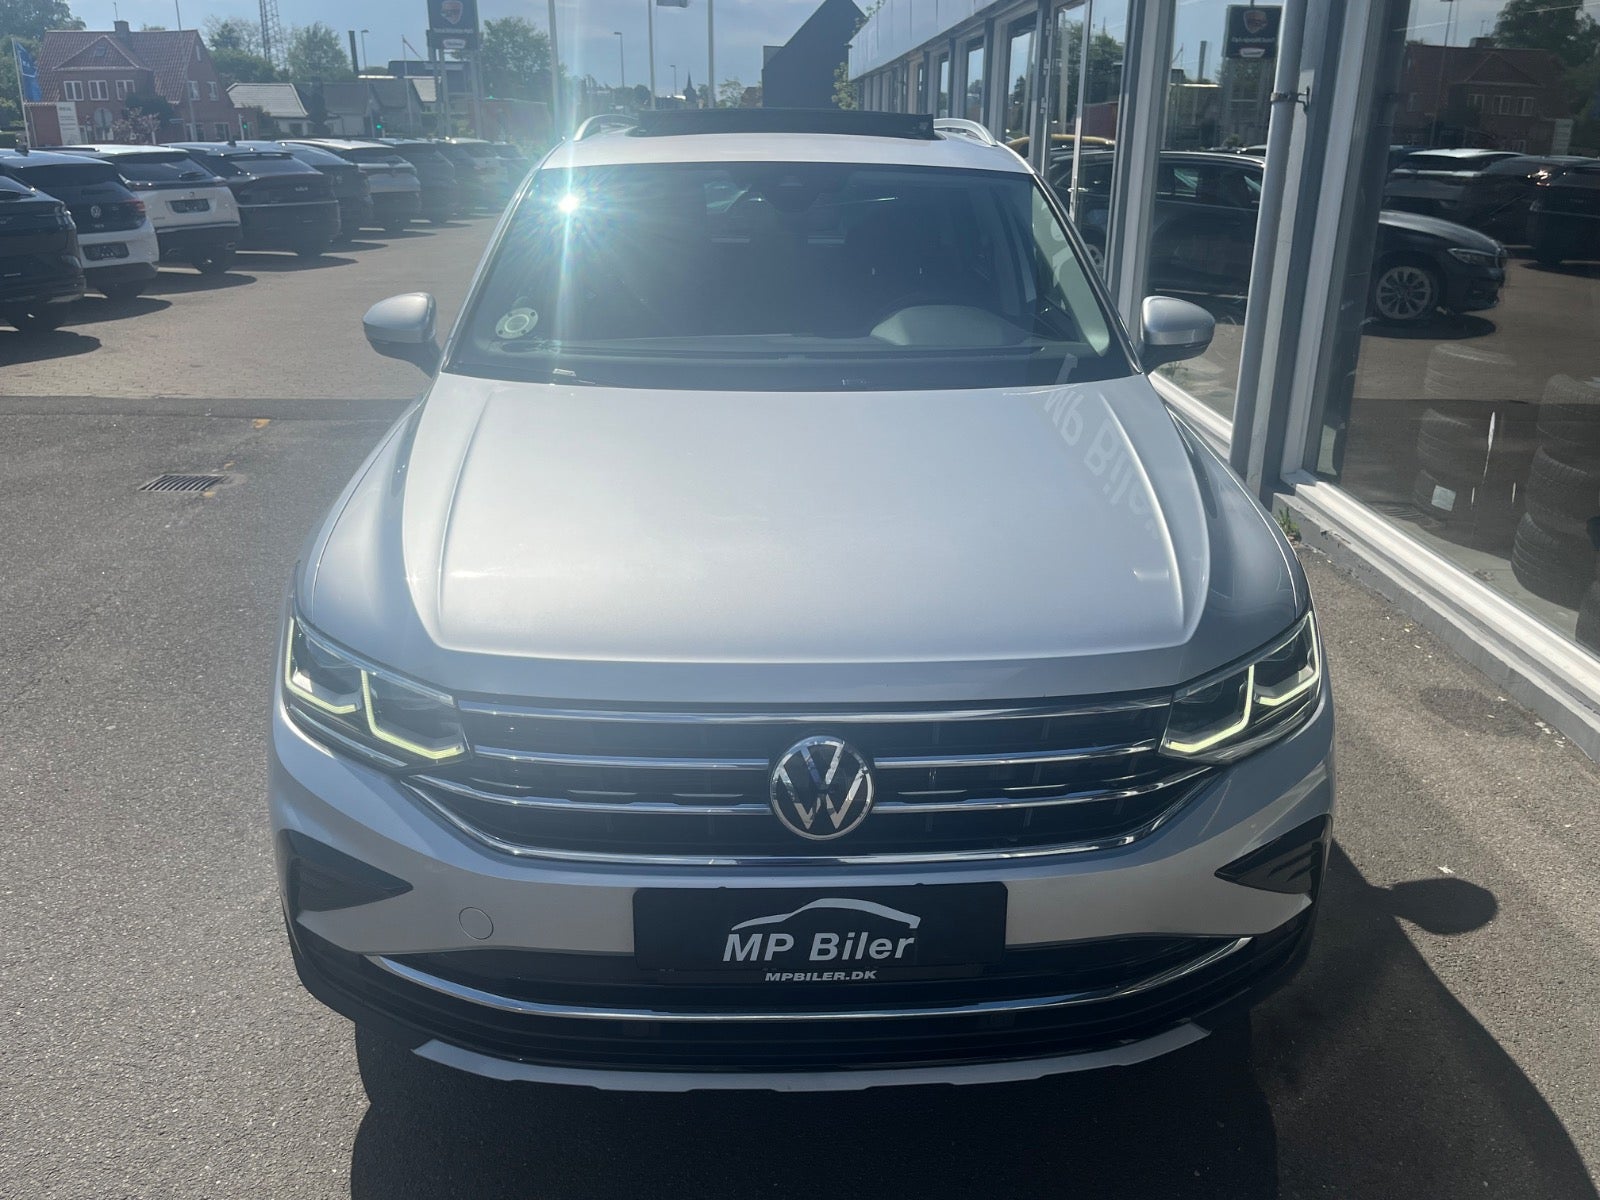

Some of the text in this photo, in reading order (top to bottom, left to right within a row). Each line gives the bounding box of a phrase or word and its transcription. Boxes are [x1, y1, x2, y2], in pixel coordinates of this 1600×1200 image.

[723, 931, 915, 962] MP Biler
[764, 969, 878, 982] MPBILER.DK
